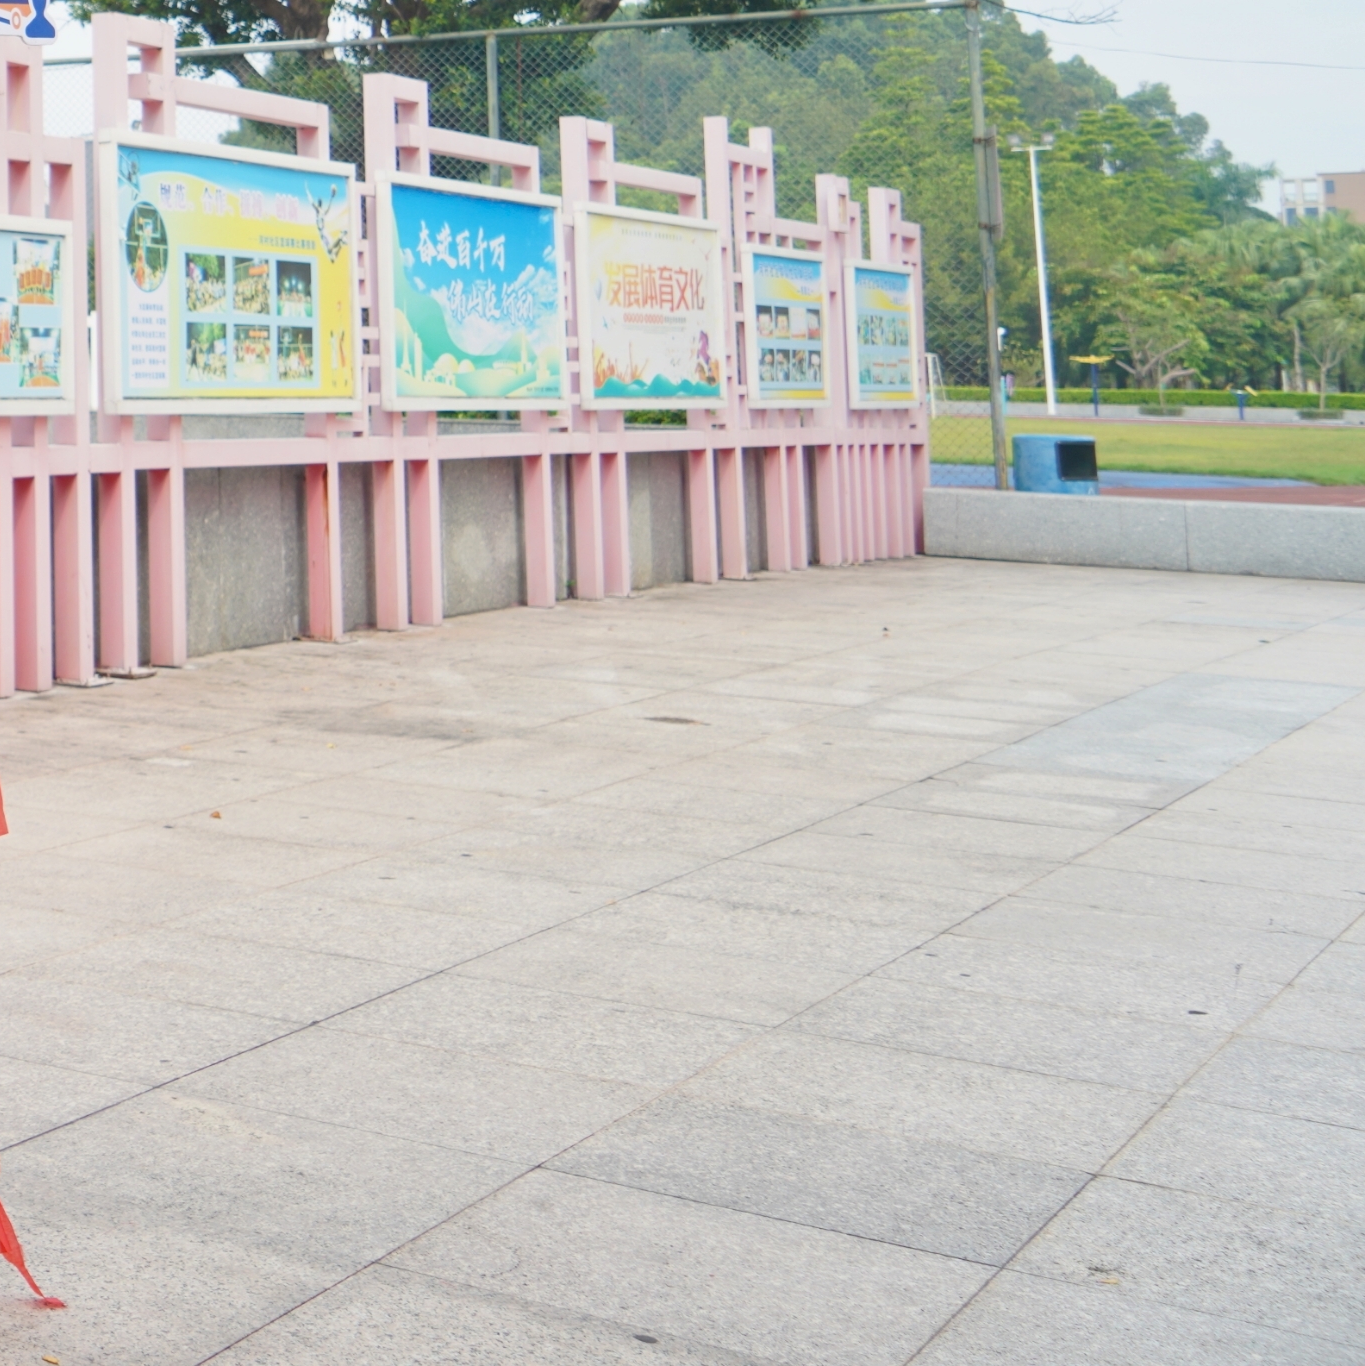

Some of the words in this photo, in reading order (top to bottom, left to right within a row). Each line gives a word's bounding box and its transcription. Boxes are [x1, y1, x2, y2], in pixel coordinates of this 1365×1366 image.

[604, 261, 705, 312] 发展体育文化
